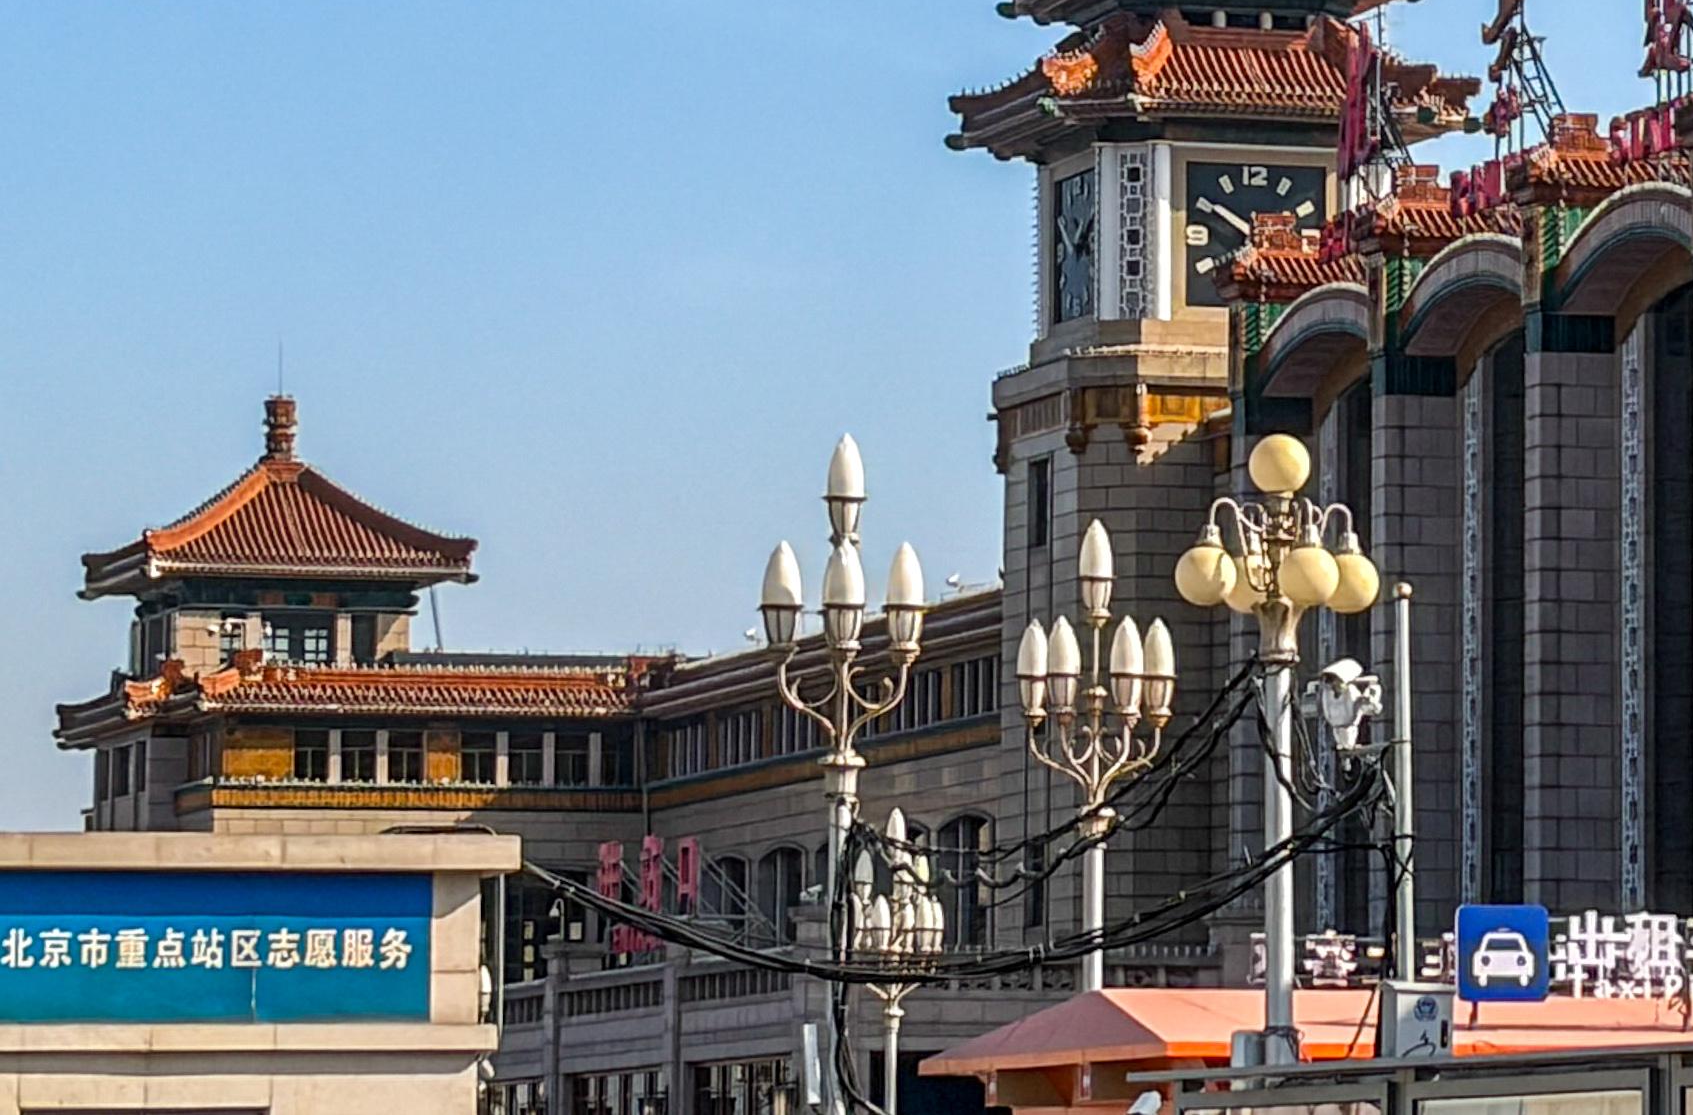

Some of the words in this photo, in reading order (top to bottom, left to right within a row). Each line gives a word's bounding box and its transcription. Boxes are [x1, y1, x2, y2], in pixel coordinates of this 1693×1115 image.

[1242, 165, 1268, 186] 12
[1186, 224, 1209, 247] 9
[1, 927, 412, 969] 北京市重点站区志愿服务
[1567, 970, 1650, 1000] Taxi
